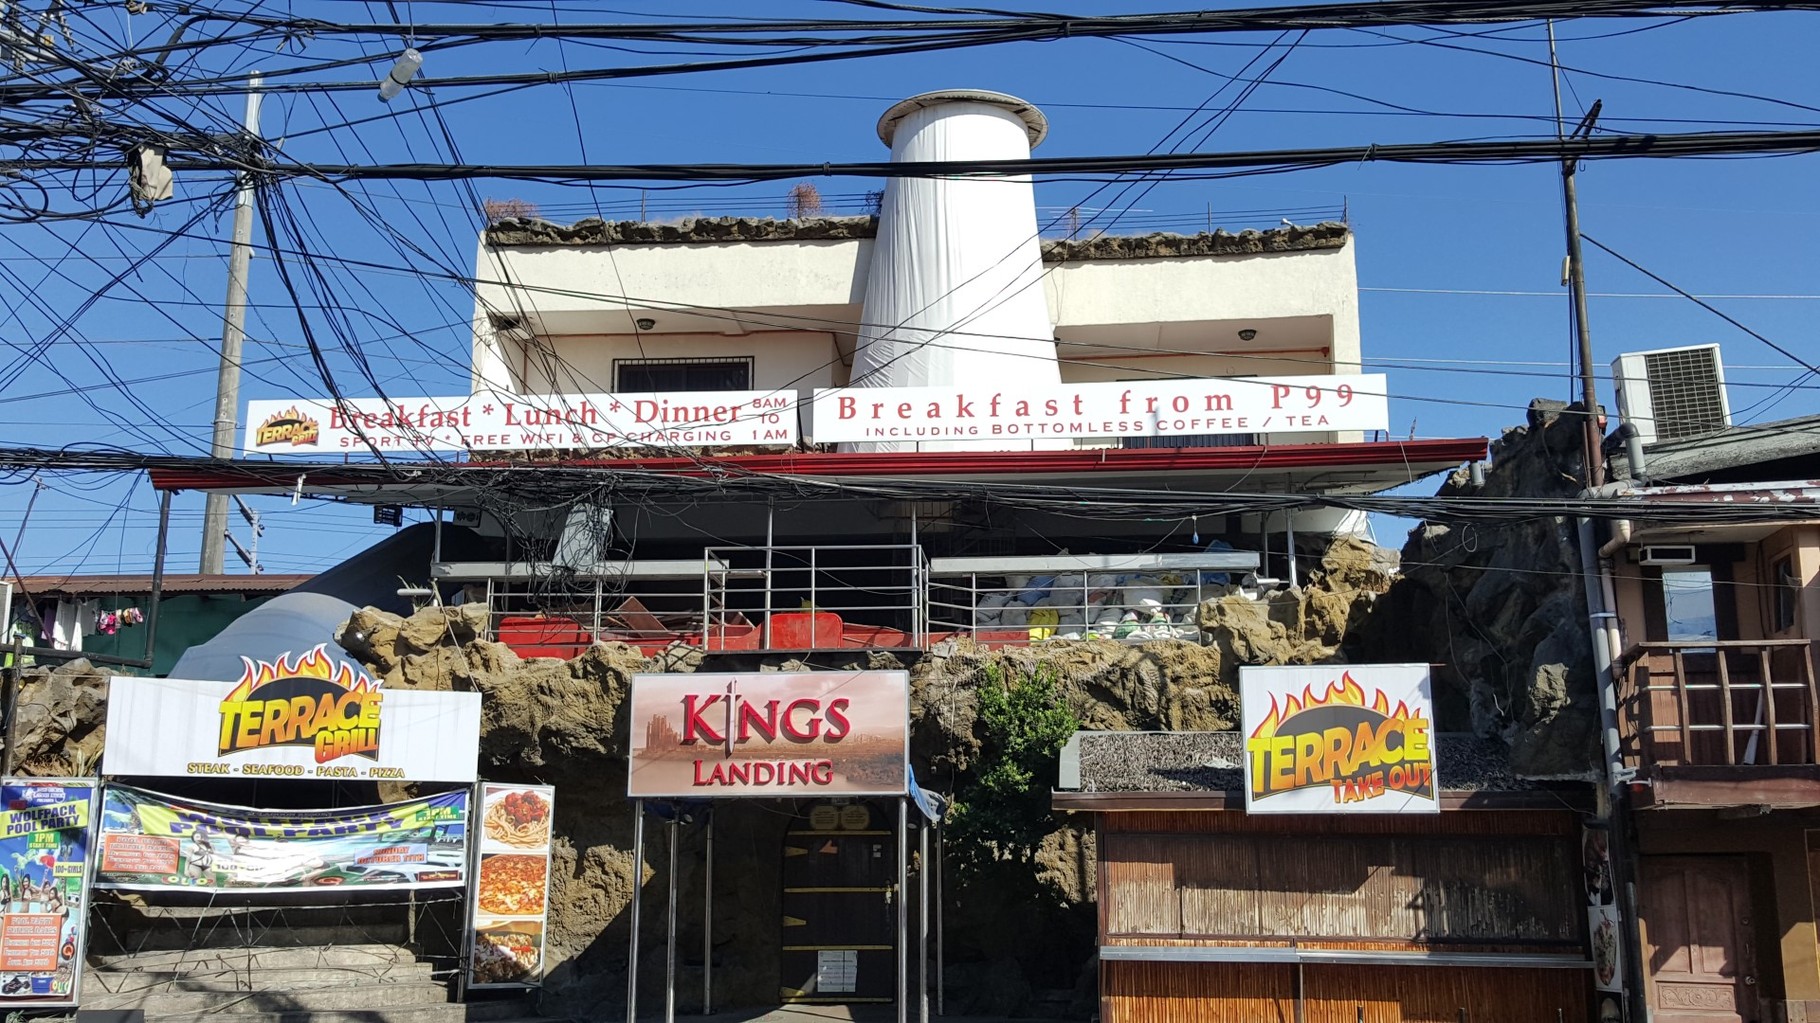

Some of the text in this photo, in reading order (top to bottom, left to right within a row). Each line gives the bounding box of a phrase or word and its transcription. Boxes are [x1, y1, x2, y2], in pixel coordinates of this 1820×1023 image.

[329, 398, 742, 430] Breakfast Lunch Dinner
[752, 398, 787, 409] 8AM
[838, 384, 1353, 420] Breakfast from P99
[256, 422, 318, 445] TERRACE
[866, 425, 979, 437] INCLUDING
[991, 421, 1143, 435] BOTTOMLESS
[1156, 417, 1248, 431] COFFEE
[1286, 415, 1329, 427] TEA
[339, 436, 402, 448] SPORT
[460, 434, 511, 446] FREE
[520, 433, 563, 445] WIFI
[592, 432, 617, 444] CP
[626, 430, 732, 443] CHARGING
[218, 691, 384, 750] TERRACE
[680, 683, 852, 755] KINGS
[315, 729, 378, 764] GRILL
[1247, 718, 1430, 794] TERRACE
[187, 762, 405, 778] STEAK SEAFOOD PASTA PIZZA
[692, 759, 834, 787] LANDING
[1330, 763, 1432, 804] TAKE OUT
[7, 814, 80, 836] POOL PARTY
[10, 804, 77, 824] WOLFPACK
[34, 833, 55, 843] 1PM
